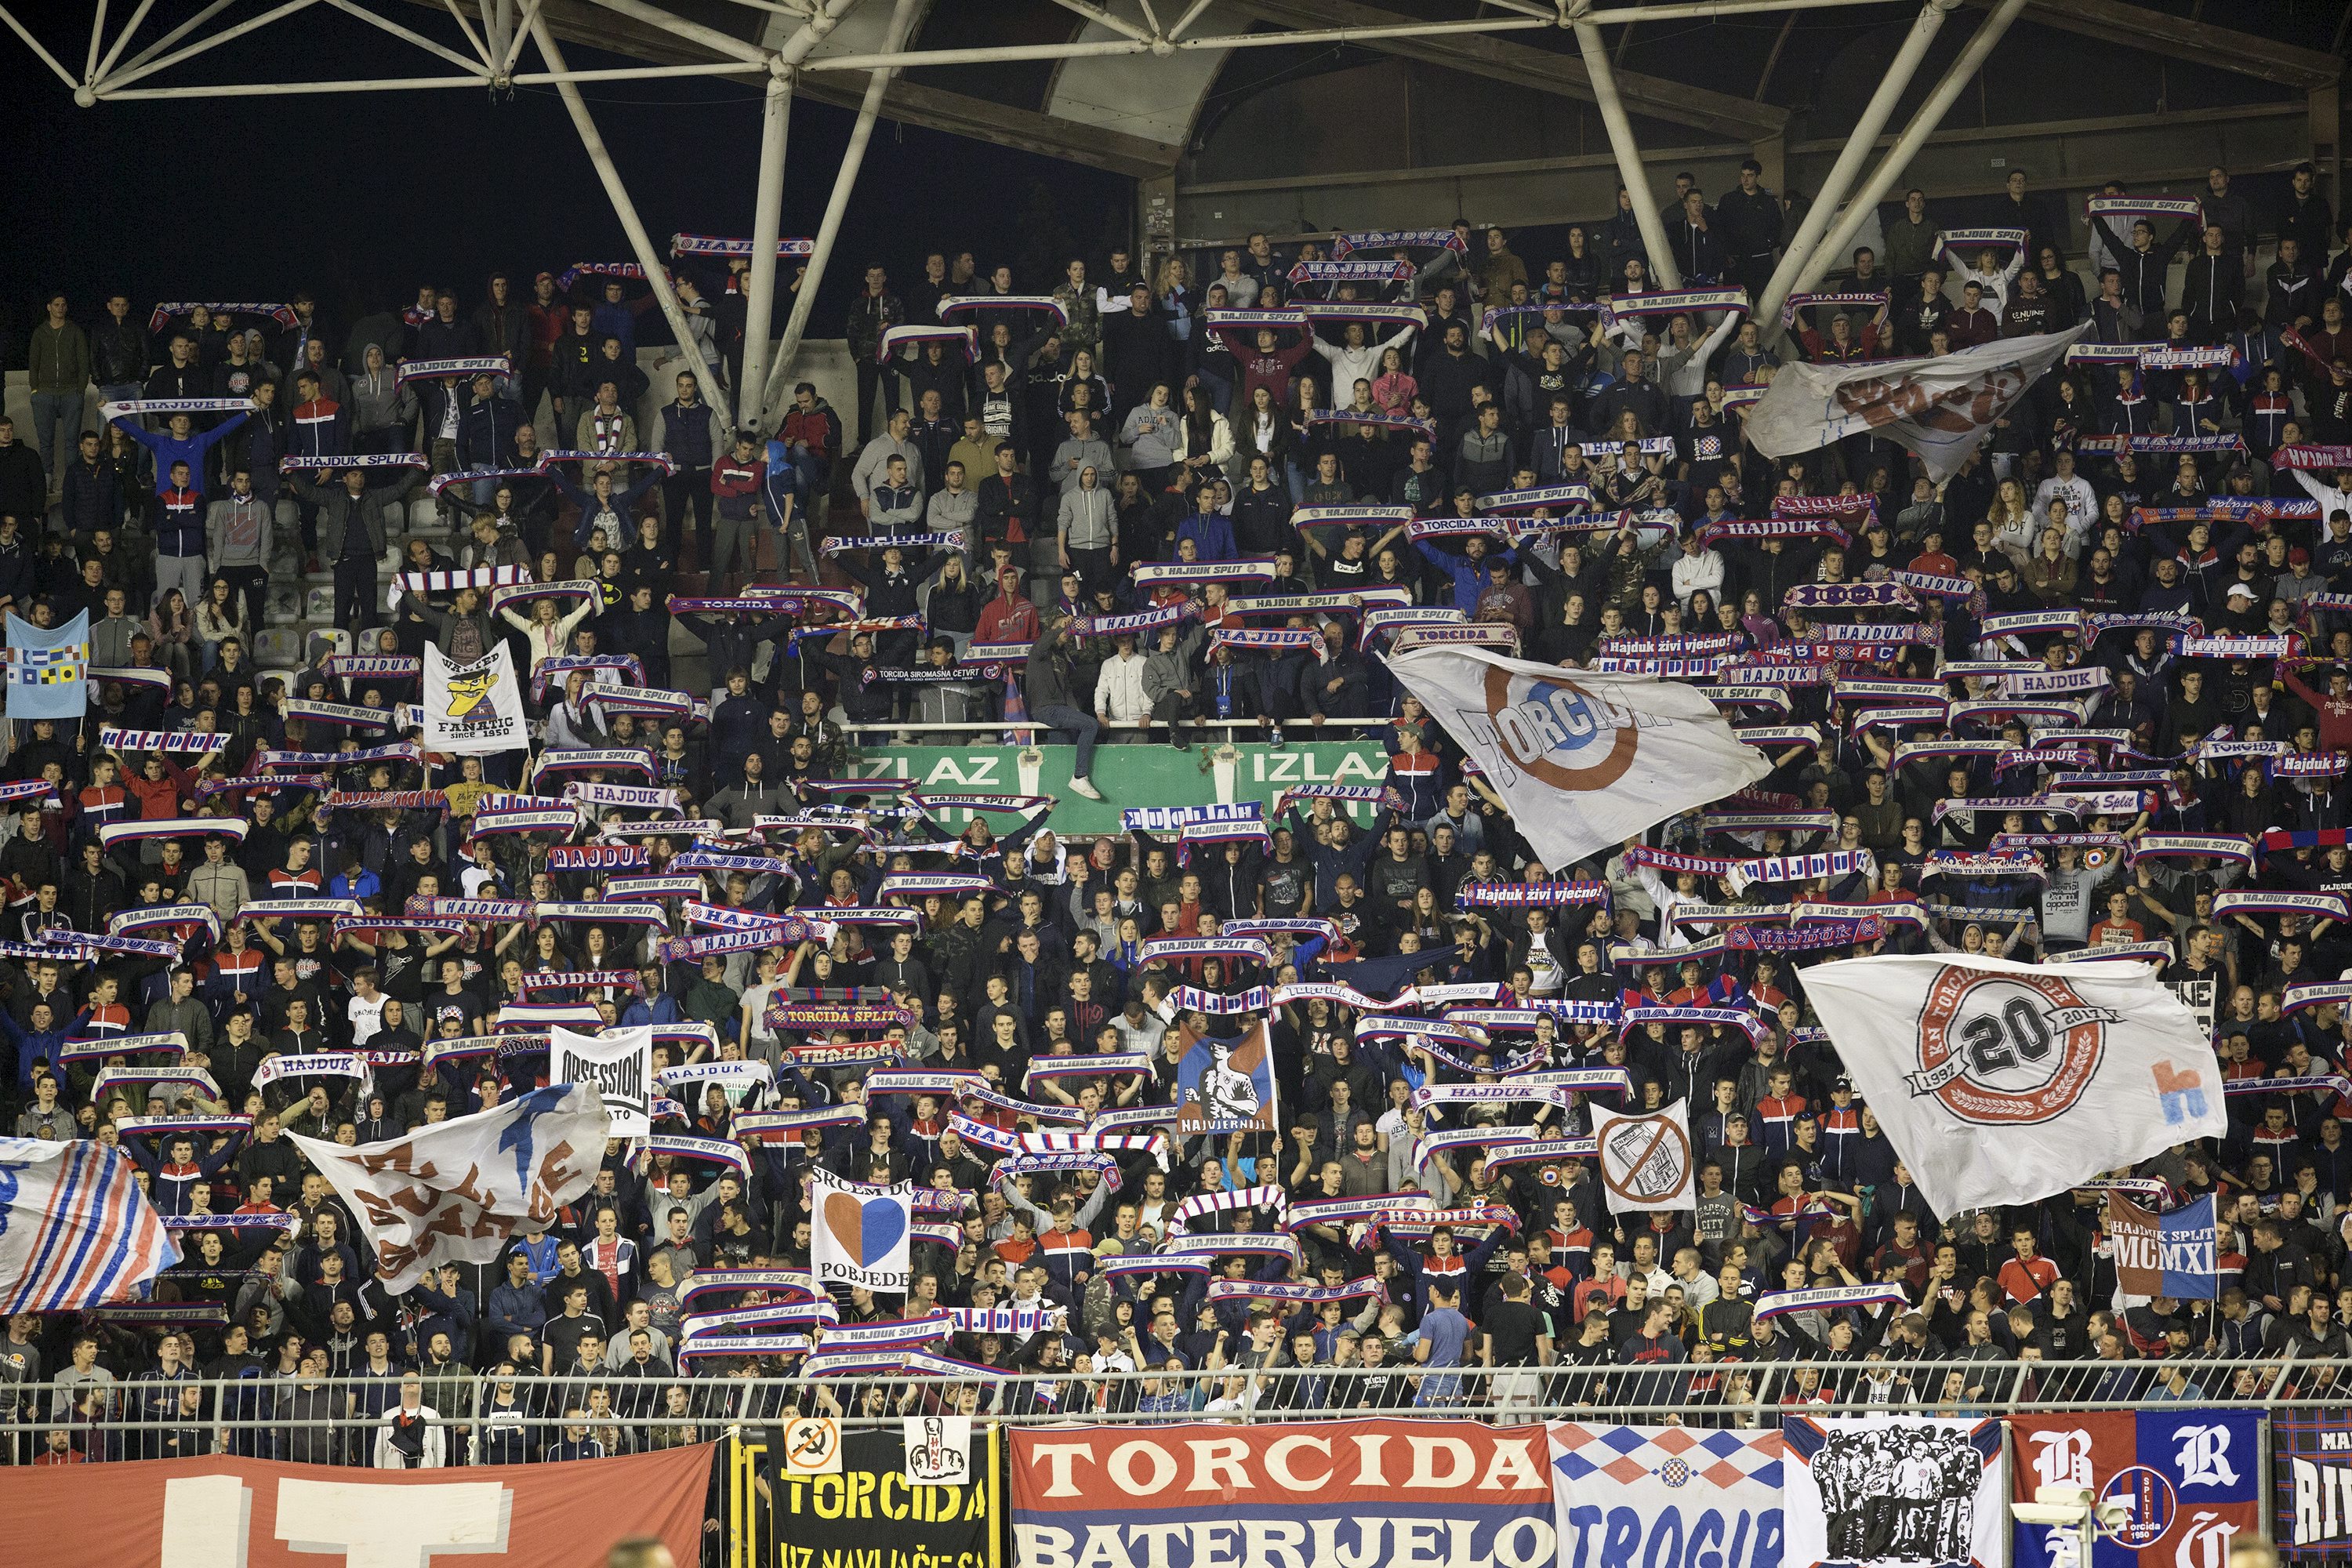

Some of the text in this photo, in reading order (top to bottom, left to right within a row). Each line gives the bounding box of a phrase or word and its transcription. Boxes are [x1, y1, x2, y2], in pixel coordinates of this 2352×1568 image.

[1348, 230, 1454, 242] HAJDUK
[1308, 262, 1395, 273] HAJDUK
[1642, 293, 1720, 307] HAJDUK SPLIT
[1221, 312, 1264, 321] HAJDUK
[2140, 350, 2230, 365] HAJDUK
[411, 358, 495, 372] HAJDUK SPLIT
[2131, 434, 2235, 445] HAJDUK
[303, 453, 408, 467] HAJDUK SPLIT
[1500, 488, 1572, 503] HAJDUK SPLIT
[1425, 521, 1474, 529] TORCIDA
[1519, 511, 1618, 528] HAJDUK
[1726, 521, 1821, 535] HAJDUK
[517, 580, 592, 592] HAJDUK SPLIT
[1905, 573, 1969, 590] HAJDUK
[1256, 597, 1340, 607] HAJDUK SPLIT
[1998, 612, 2070, 626] HAJDUK SPLIT
[1218, 630, 1312, 643] HAJDUK
[1416, 630, 1488, 640] TORCIDA
[1839, 626, 1905, 640] HAJDUK
[1610, 633, 1732, 653] Hajduk živi vječno!
[2187, 639, 2288, 652] HAJDUK
[346, 659, 412, 671] HAJDUK
[1602, 659, 1722, 672] HAJDUK
[880, 670, 908, 678] TORCIDA
[2024, 672, 2089, 688] HAJDUK
[310, 703, 381, 720] HAJDUK SPLIT
[439, 718, 514, 731] FANATIC
[484, 728, 510, 736] 1950
[103, 731, 228, 748] HAJDUK
[280, 746, 386, 760] HAJDUK
[2212, 742, 2278, 752] TORCIDA
[556, 751, 637, 760] HAJDUK SPLIT
[2012, 750, 2078, 762] HAJDUK
[2285, 758, 2330, 771] Hajduk
[593, 787, 659, 803] HAJDUK
[1300, 785, 1370, 797] HAJDUK
[983, 797, 1016, 805] SPLIT
[1965, 797, 2046, 808] HAJDUK
[2102, 796, 2134, 809] Split
[619, 822, 708, 830] TORCIDA
[553, 848, 649, 866] HAJDUK
[1744, 854, 1868, 878] HAJDUK
[1476, 888, 1602, 901] Hajduk živi vječno!
[126, 908, 205, 920] HAJDUK SPLIT
[573, 905, 654, 915] HAJDUK SPLIT
[336, 917, 418, 928] HAJDUK
[53, 931, 162, 951] HAJDUK
[706, 929, 772, 946] HAJDUK
[1757, 929, 1852, 943] HAJDUK
[1160, 941, 1207, 950] HAJDUK
[525, 972, 619, 985] HAJDUK
[788, 1011, 897, 1022] TORCIDA SPLIT
[1633, 1009, 1740, 1022] HAJDUK
[2062, 1008, 2100, 1024] 2017
[1961, 996, 2053, 1076] 20
[800, 1044, 893, 1063] TORCIDA
[283, 1059, 352, 1071] HAJDUK
[666, 1064, 743, 1080] HAJDUK
[1534, 1073, 1615, 1084] HAJDUK SPLIT
[1924, 1062, 1955, 1087] 1997
[1452, 1087, 1532, 1097] HAJDUK
[1181, 1119, 1265, 1131] NAJVJERNIJI
[652, 1138, 731, 1152] HAJDUK SPLIT
[1002, 1155, 1113, 1166] HAJDUK
[813, 1167, 884, 1197] SRCEM
[1389, 1209, 1488, 1221] HAJDUK
[2113, 1221, 2214, 1240] HAJDUK SPLIT
[1186, 1238, 1278, 1247] HAJDUK SPLIT
[2114, 1235, 2215, 1274] MCMXI
[710, 1274, 760, 1283] HAJDUK
[821, 1263, 909, 1287] POBJEDE
[1248, 1282, 1363, 1297] HAJDUK
[1791, 1287, 1879, 1301] HAJDUK SPLIT
[1032, 1434, 1548, 1497] TORCIDA
[781, 1468, 986, 1522] TORCIDA
[1016, 1517, 1555, 1568] BATERIJELO
